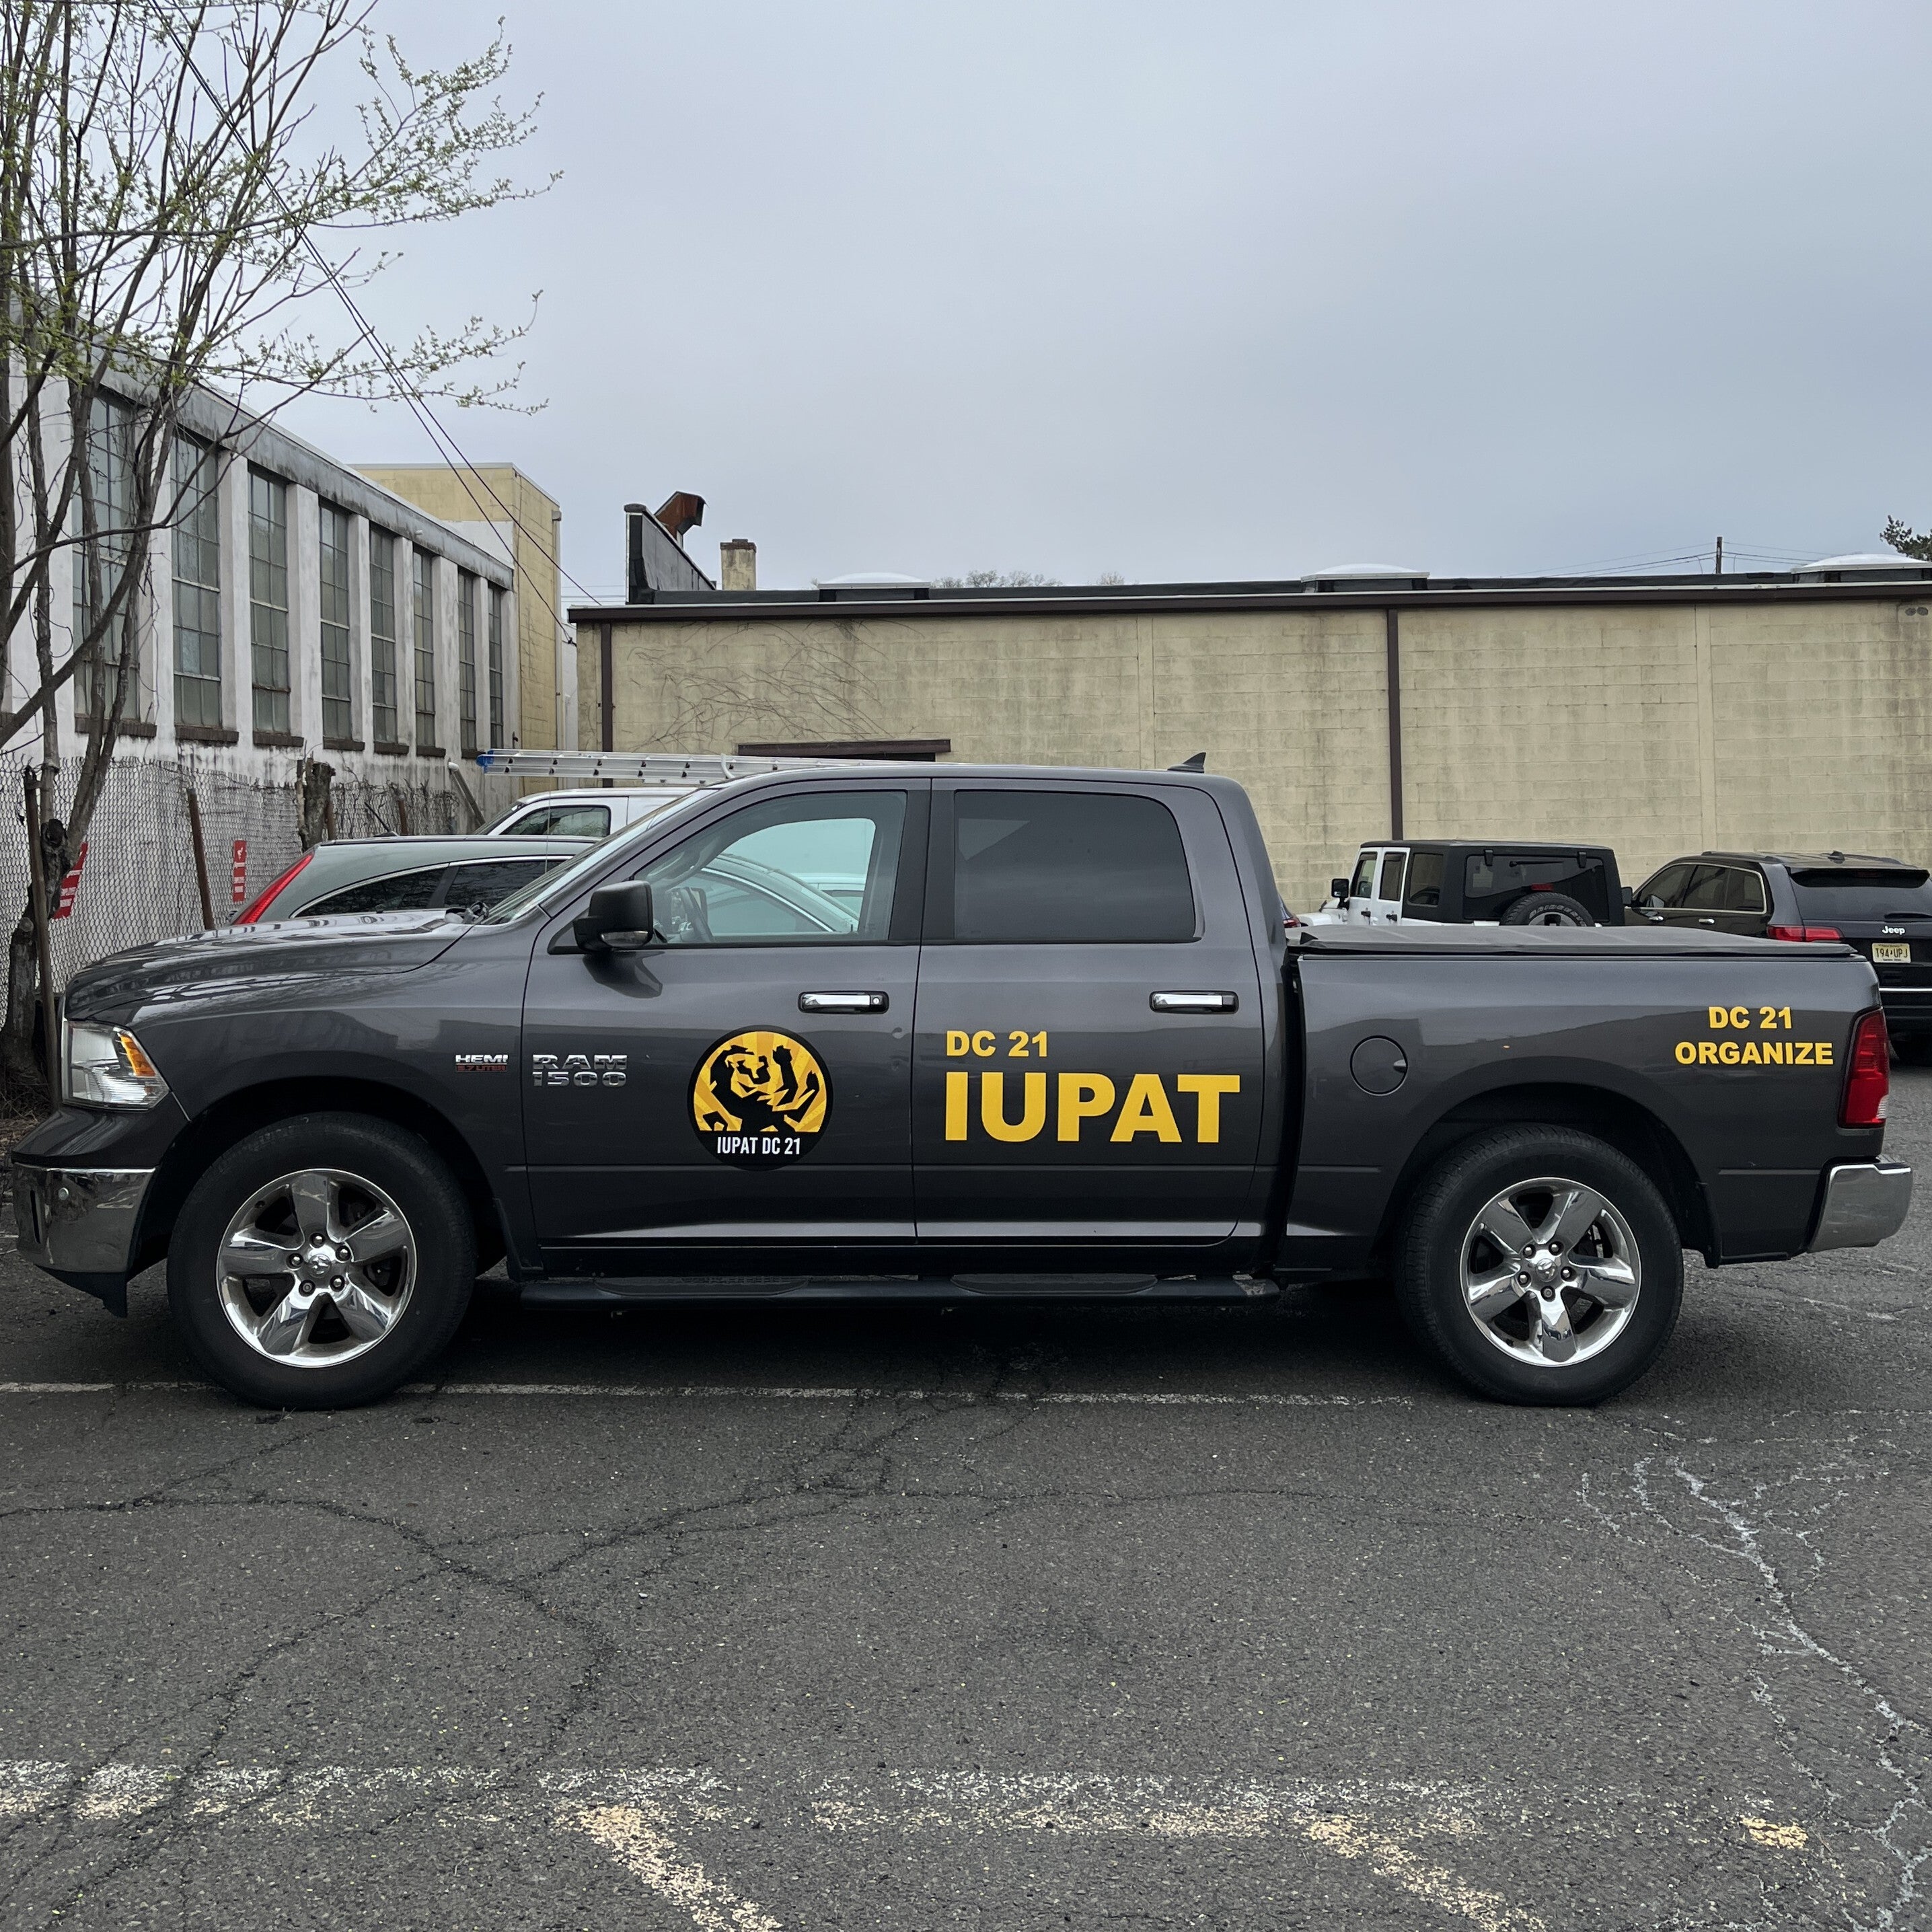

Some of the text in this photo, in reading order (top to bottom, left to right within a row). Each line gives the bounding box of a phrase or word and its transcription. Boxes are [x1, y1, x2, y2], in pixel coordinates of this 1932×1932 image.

[1882, 926, 1905, 935] Jeep
[1708, 1006, 1792, 1029] DC 21
[946, 1031, 1047, 1057] DC 21
[1674, 1041, 1834, 1065] ORGANIZE
[455, 1054, 509, 1063] HEMI
[532, 1054, 628, 1070] RAM
[532, 1071, 626, 1087] 1500
[945, 1072, 1240, 1144] IUPAT
[717, 1136, 801, 1155] IUPAT DC 21
